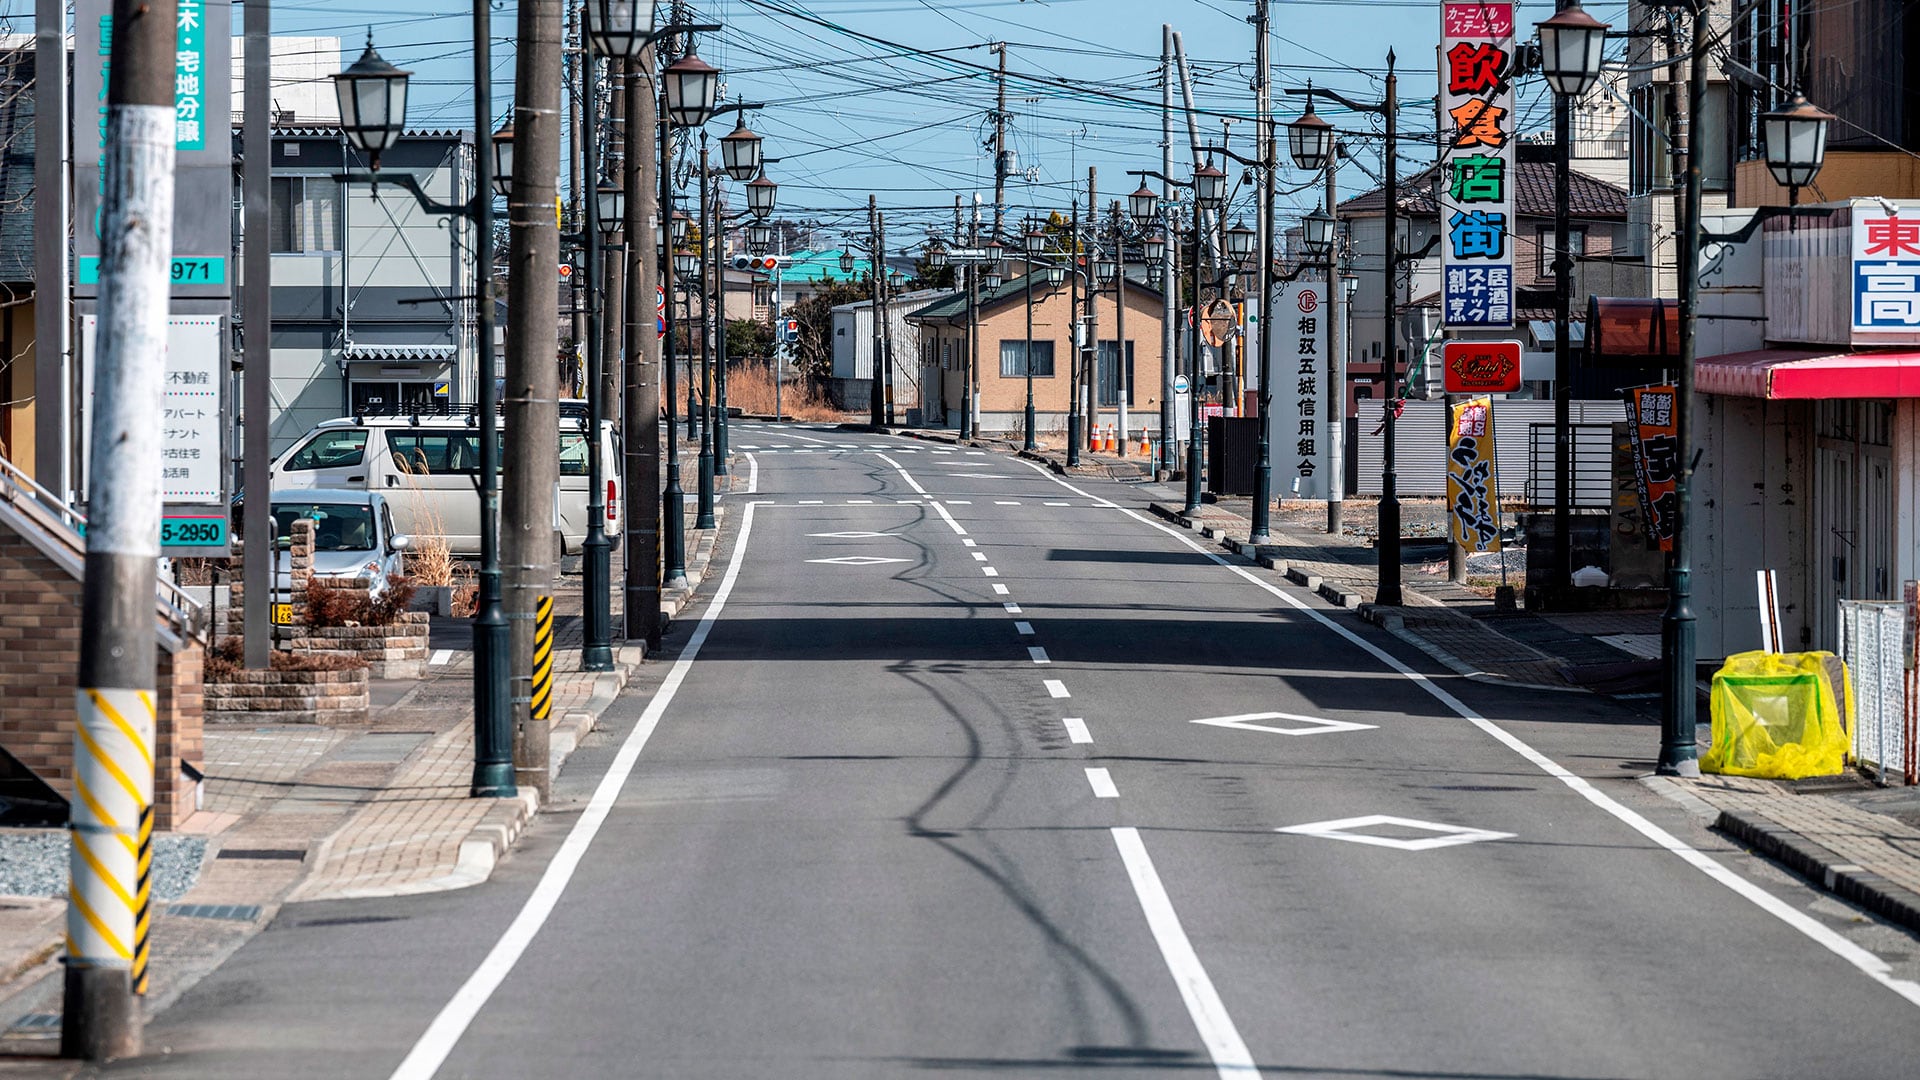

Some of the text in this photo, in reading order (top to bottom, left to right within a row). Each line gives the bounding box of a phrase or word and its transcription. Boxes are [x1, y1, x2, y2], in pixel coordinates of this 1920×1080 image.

[1447, 7, 1498, 20] カーニバル
[1451, 20, 1509, 34] ステーション
[1447, 42, 1509, 260] 飲食店街
[1864, 217, 1920, 257] 東
[1448, 268, 1467, 322] 割烹
[1467, 268, 1487, 322] スナック
[1487, 268, 1509, 322] 居酒屋
[1860, 262, 1920, 325] 高
[1297, 317, 1317, 477] 相双五城信用組合
